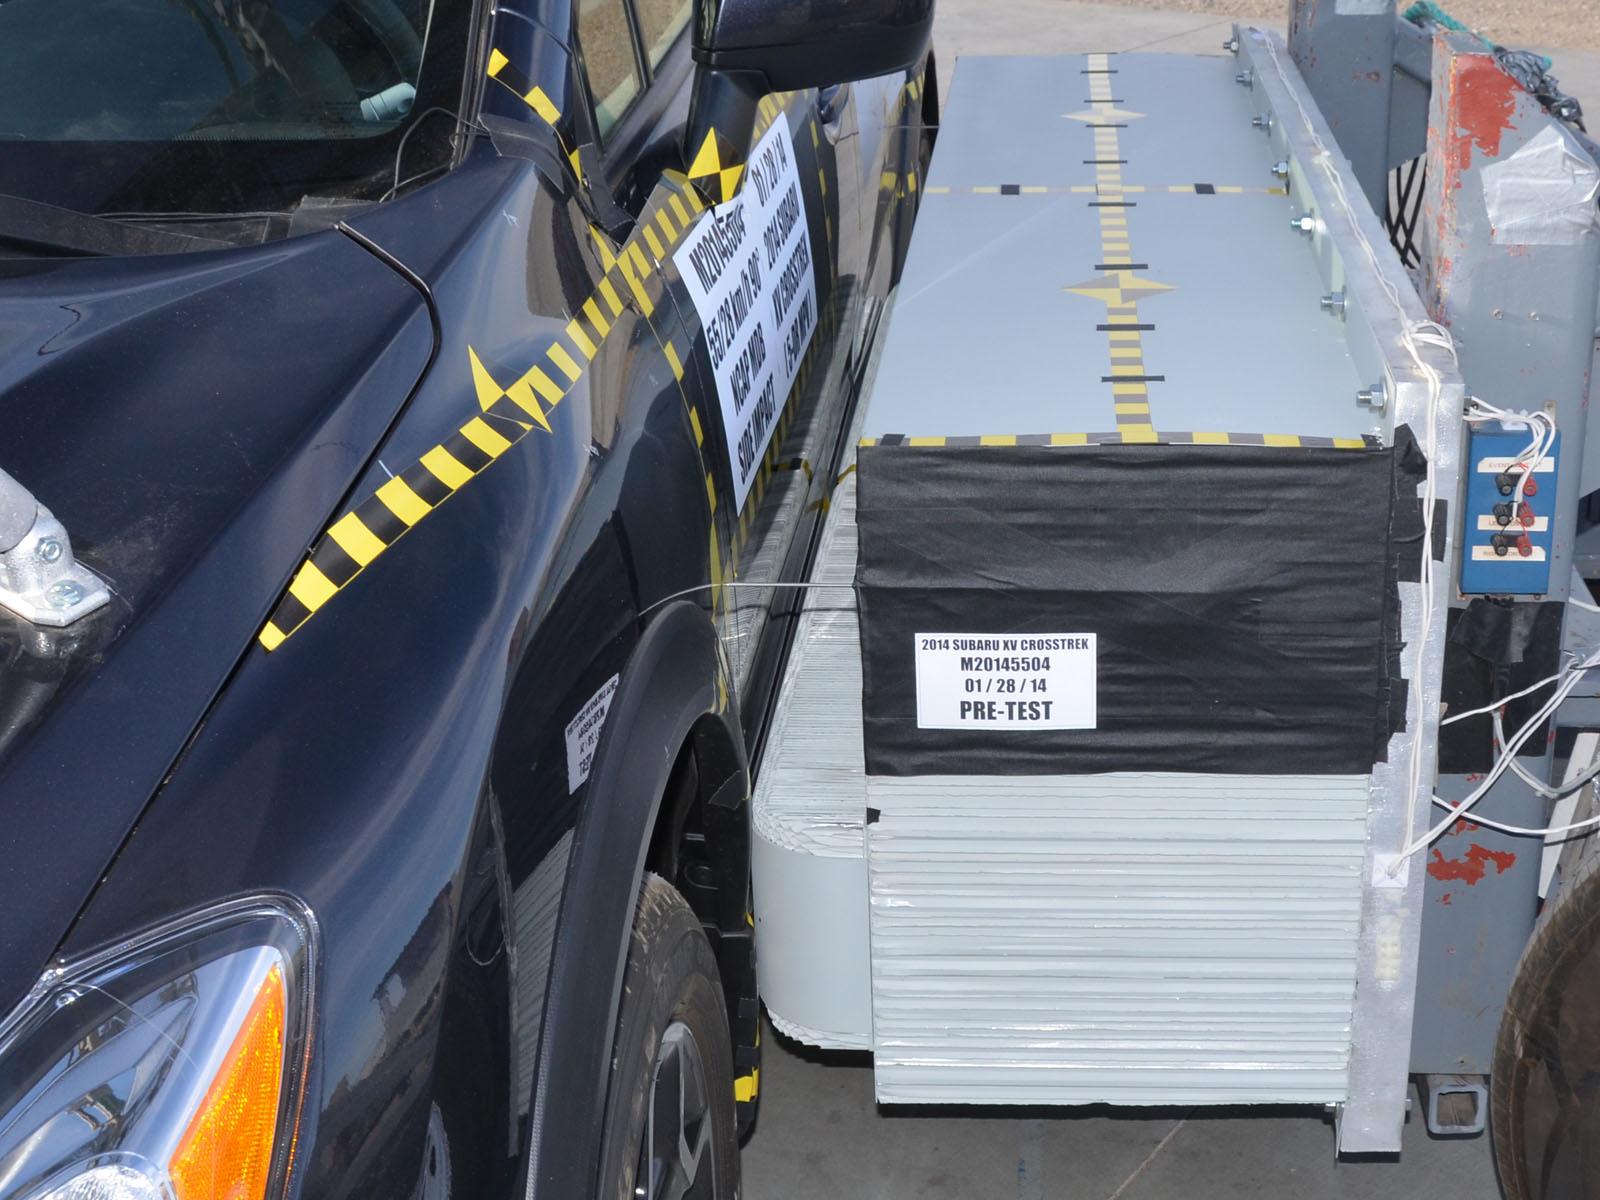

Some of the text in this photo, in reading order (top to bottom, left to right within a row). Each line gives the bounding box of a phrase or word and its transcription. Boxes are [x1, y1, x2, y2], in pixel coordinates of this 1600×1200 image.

[763, 181, 800, 271] 2014 SUBARU
[706, 297, 736, 370] 55/28
[729, 269, 754, 331] km/h
[730, 321, 766, 416] NCAP MDB
[738, 372, 776, 485] SIDE IMPACT
[921, 638, 1089, 651] 2014 SUBARU XV CROSSTREK
[960, 656, 1051, 672] M20145504
[959, 700, 1053, 721] PRE-TEST
